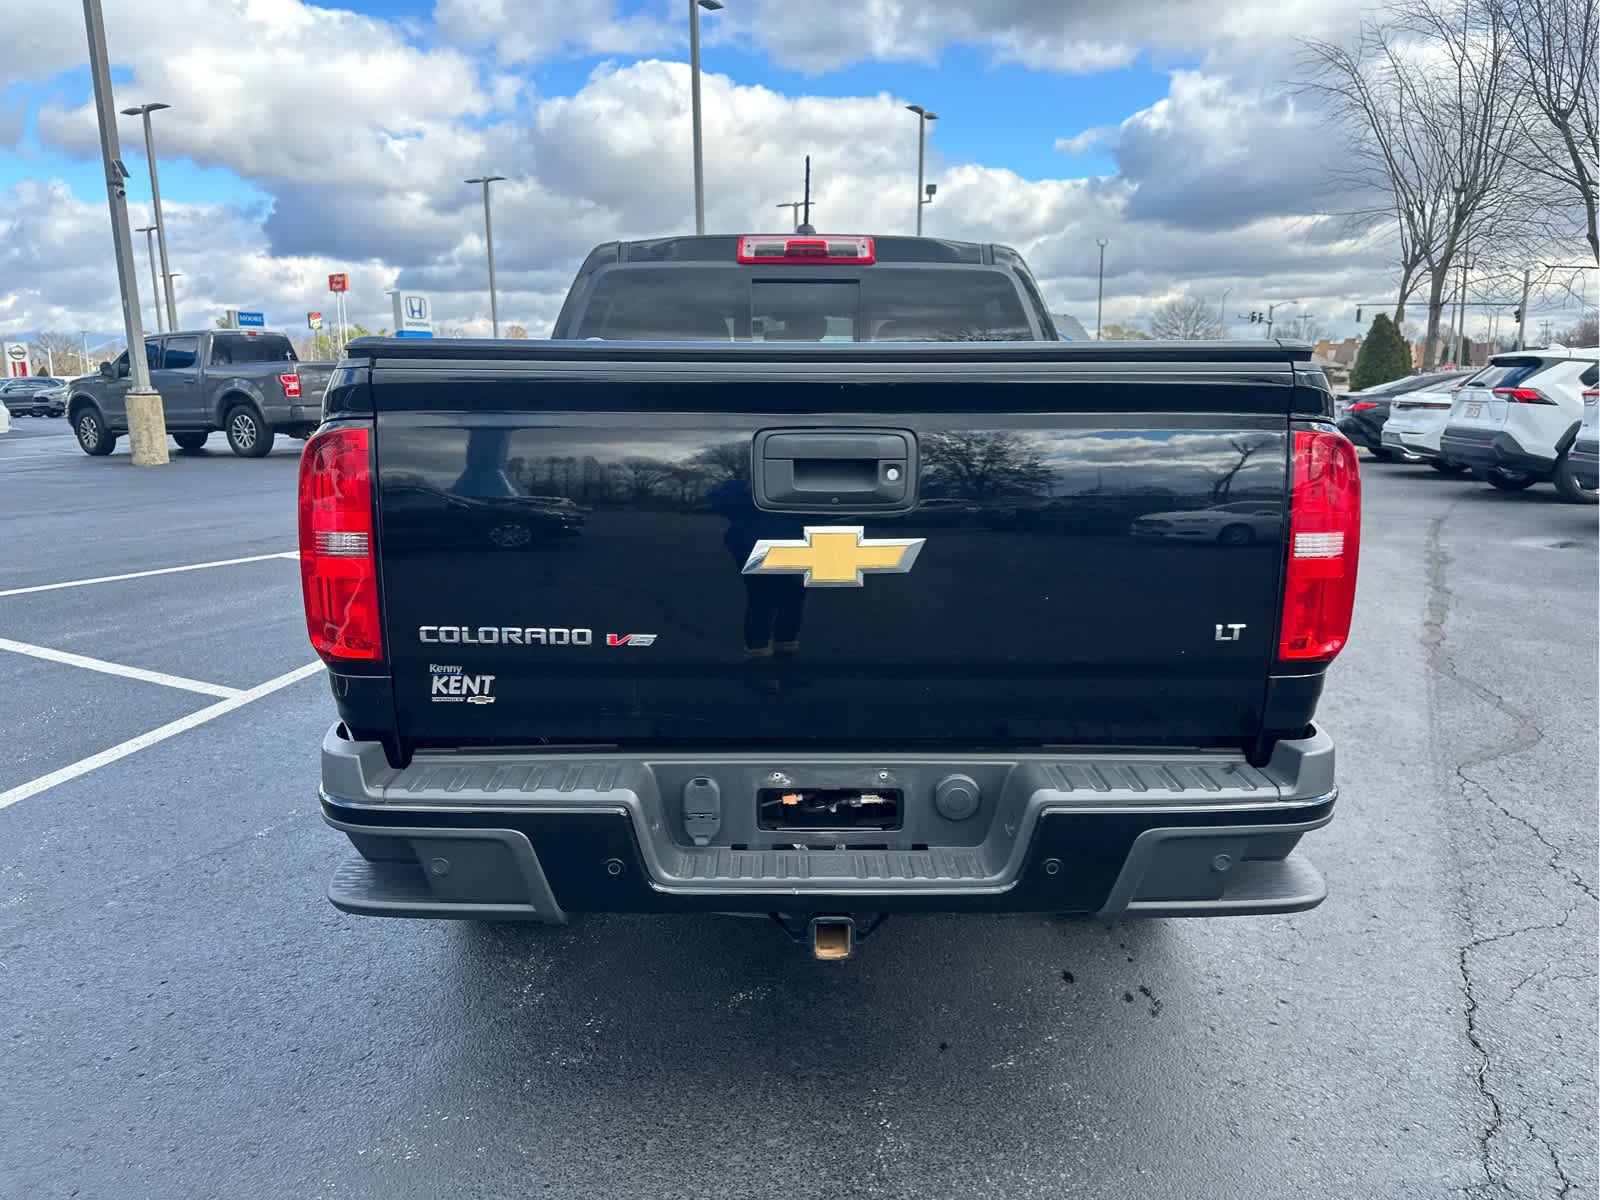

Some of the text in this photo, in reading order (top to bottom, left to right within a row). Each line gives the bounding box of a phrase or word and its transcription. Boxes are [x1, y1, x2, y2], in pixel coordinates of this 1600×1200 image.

[419, 625, 658, 646] COLORADO V6
[1215, 623, 1247, 641] LT
[429, 663, 463, 676] Kenny
[431, 675, 496, 695] KENT
